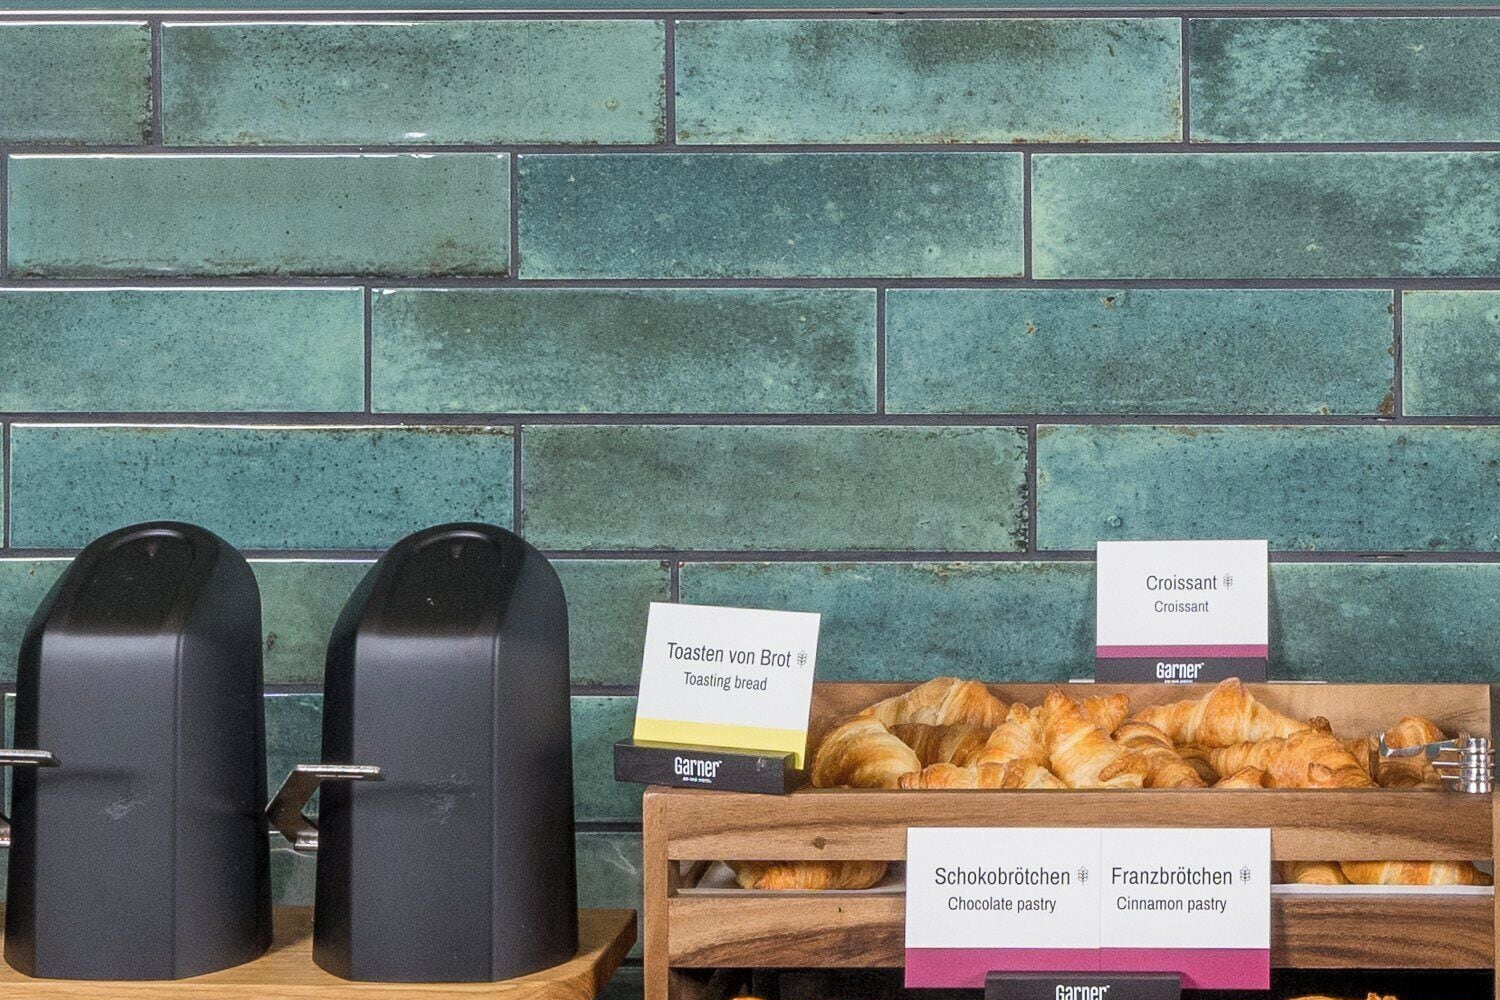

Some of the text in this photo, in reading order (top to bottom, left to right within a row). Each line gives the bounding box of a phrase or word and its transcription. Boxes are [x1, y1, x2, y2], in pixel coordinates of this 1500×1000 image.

[1146, 574, 1218, 591] Croissant
[1154, 600, 1209, 613] Croissant
[667, 641, 792, 669] Toasten von Brot
[1156, 662, 1203, 678] Garner
[683, 671, 768, 692] Toasting bread
[674, 756, 719, 778] Garner
[934, 866, 1070, 886] Schokobrötchen
[1111, 866, 1233, 886] Franzbrötchen
[947, 895, 1057, 914] Chocolate pastry
[1116, 896, 1227, 914] Cinnamon pastry
